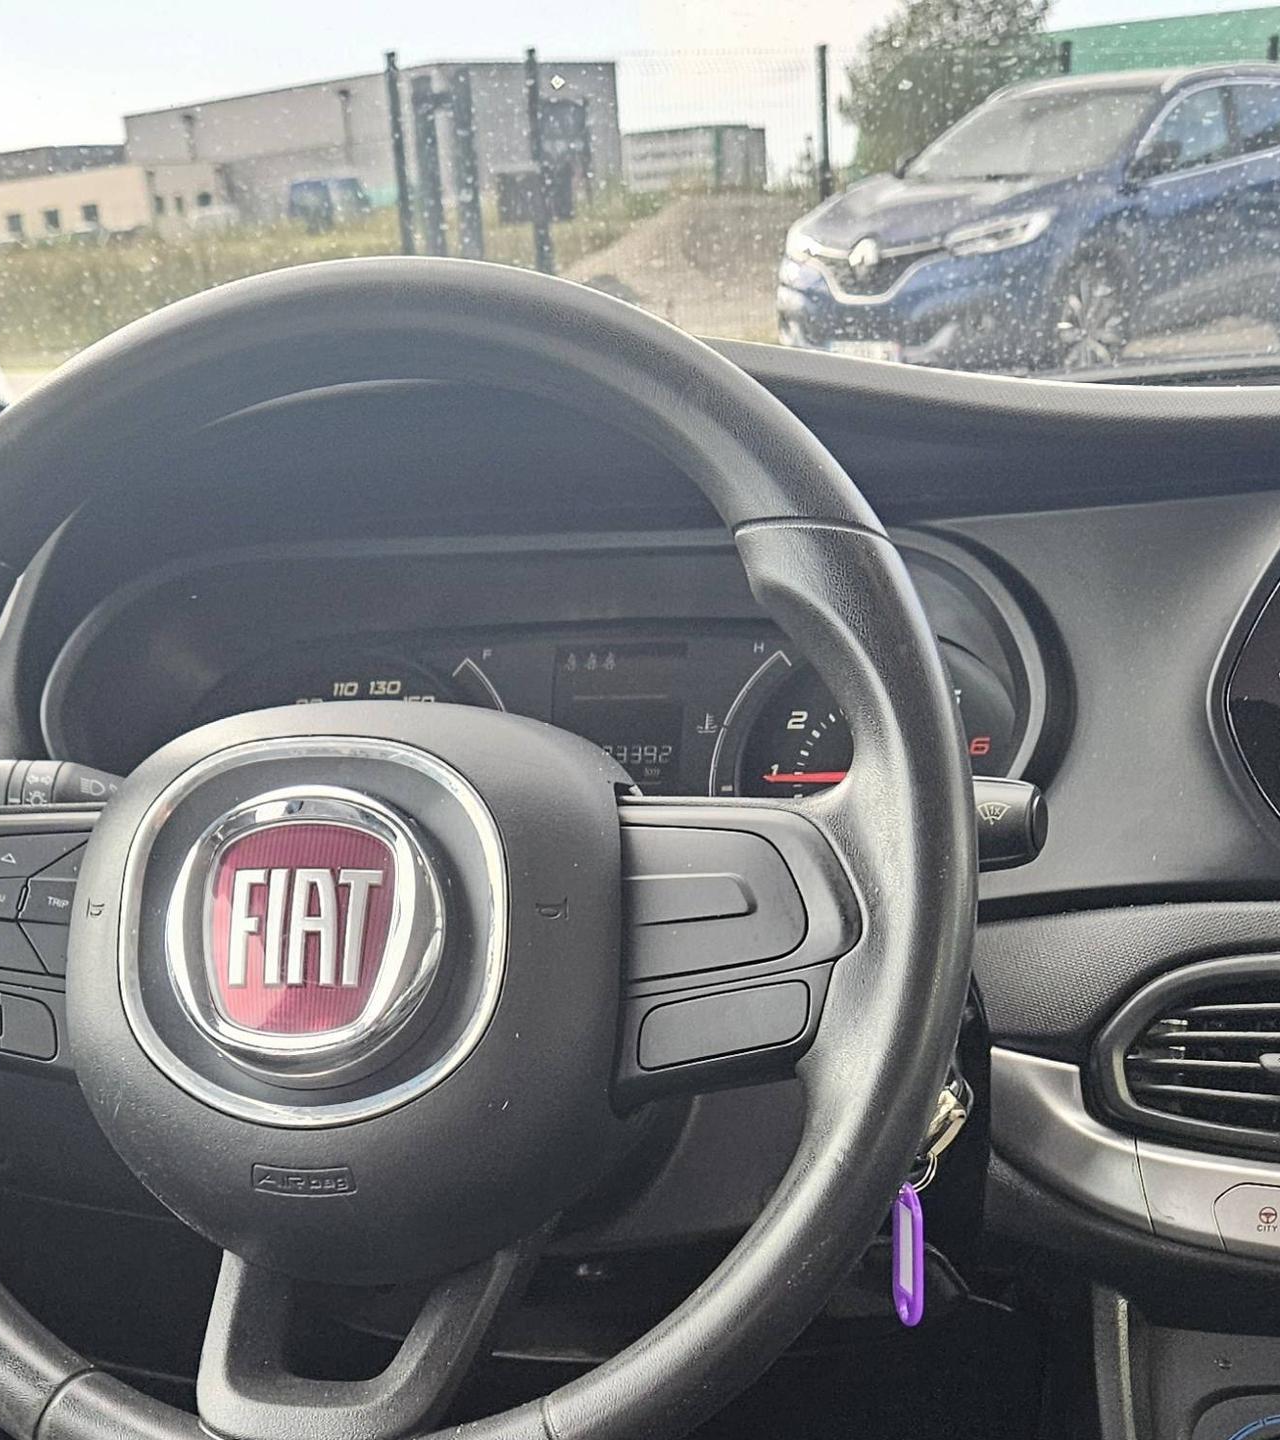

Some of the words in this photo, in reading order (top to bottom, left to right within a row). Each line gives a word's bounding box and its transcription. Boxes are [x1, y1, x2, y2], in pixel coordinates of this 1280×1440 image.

[482, 649, 493, 661] F
[753, 642, 765, 653] H
[333, 682, 358, 697] 110
[370, 680, 401, 695] 130
[787, 710, 808, 730] 2
[970, 736, 991, 756] 6
[47, 896, 69, 909] TRIP
[228, 868, 384, 988] FIAT
[1256, 1224, 1278, 1233] CITY
